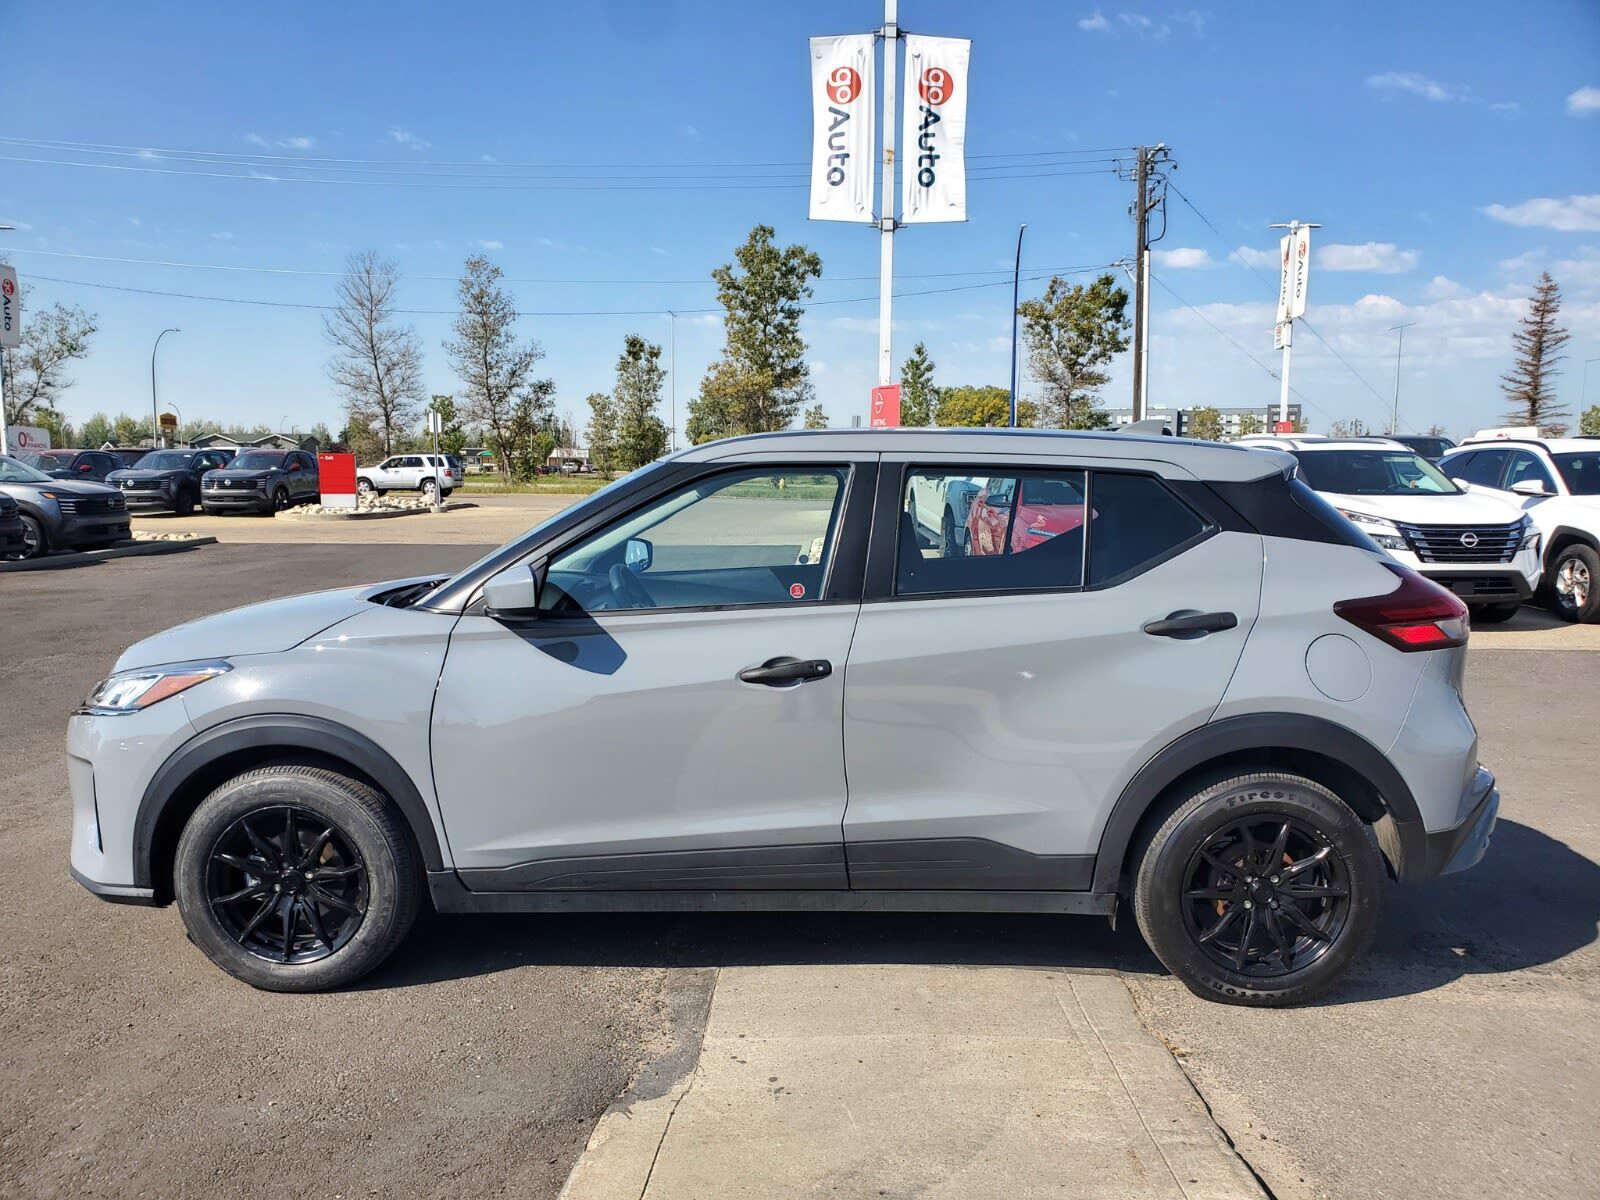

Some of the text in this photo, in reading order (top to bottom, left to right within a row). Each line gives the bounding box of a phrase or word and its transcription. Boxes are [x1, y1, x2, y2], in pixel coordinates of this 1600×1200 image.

[827, 67, 856, 187] go Auto
[918, 67, 948, 188] go Auto
[3, 295, 12, 331] Auto
